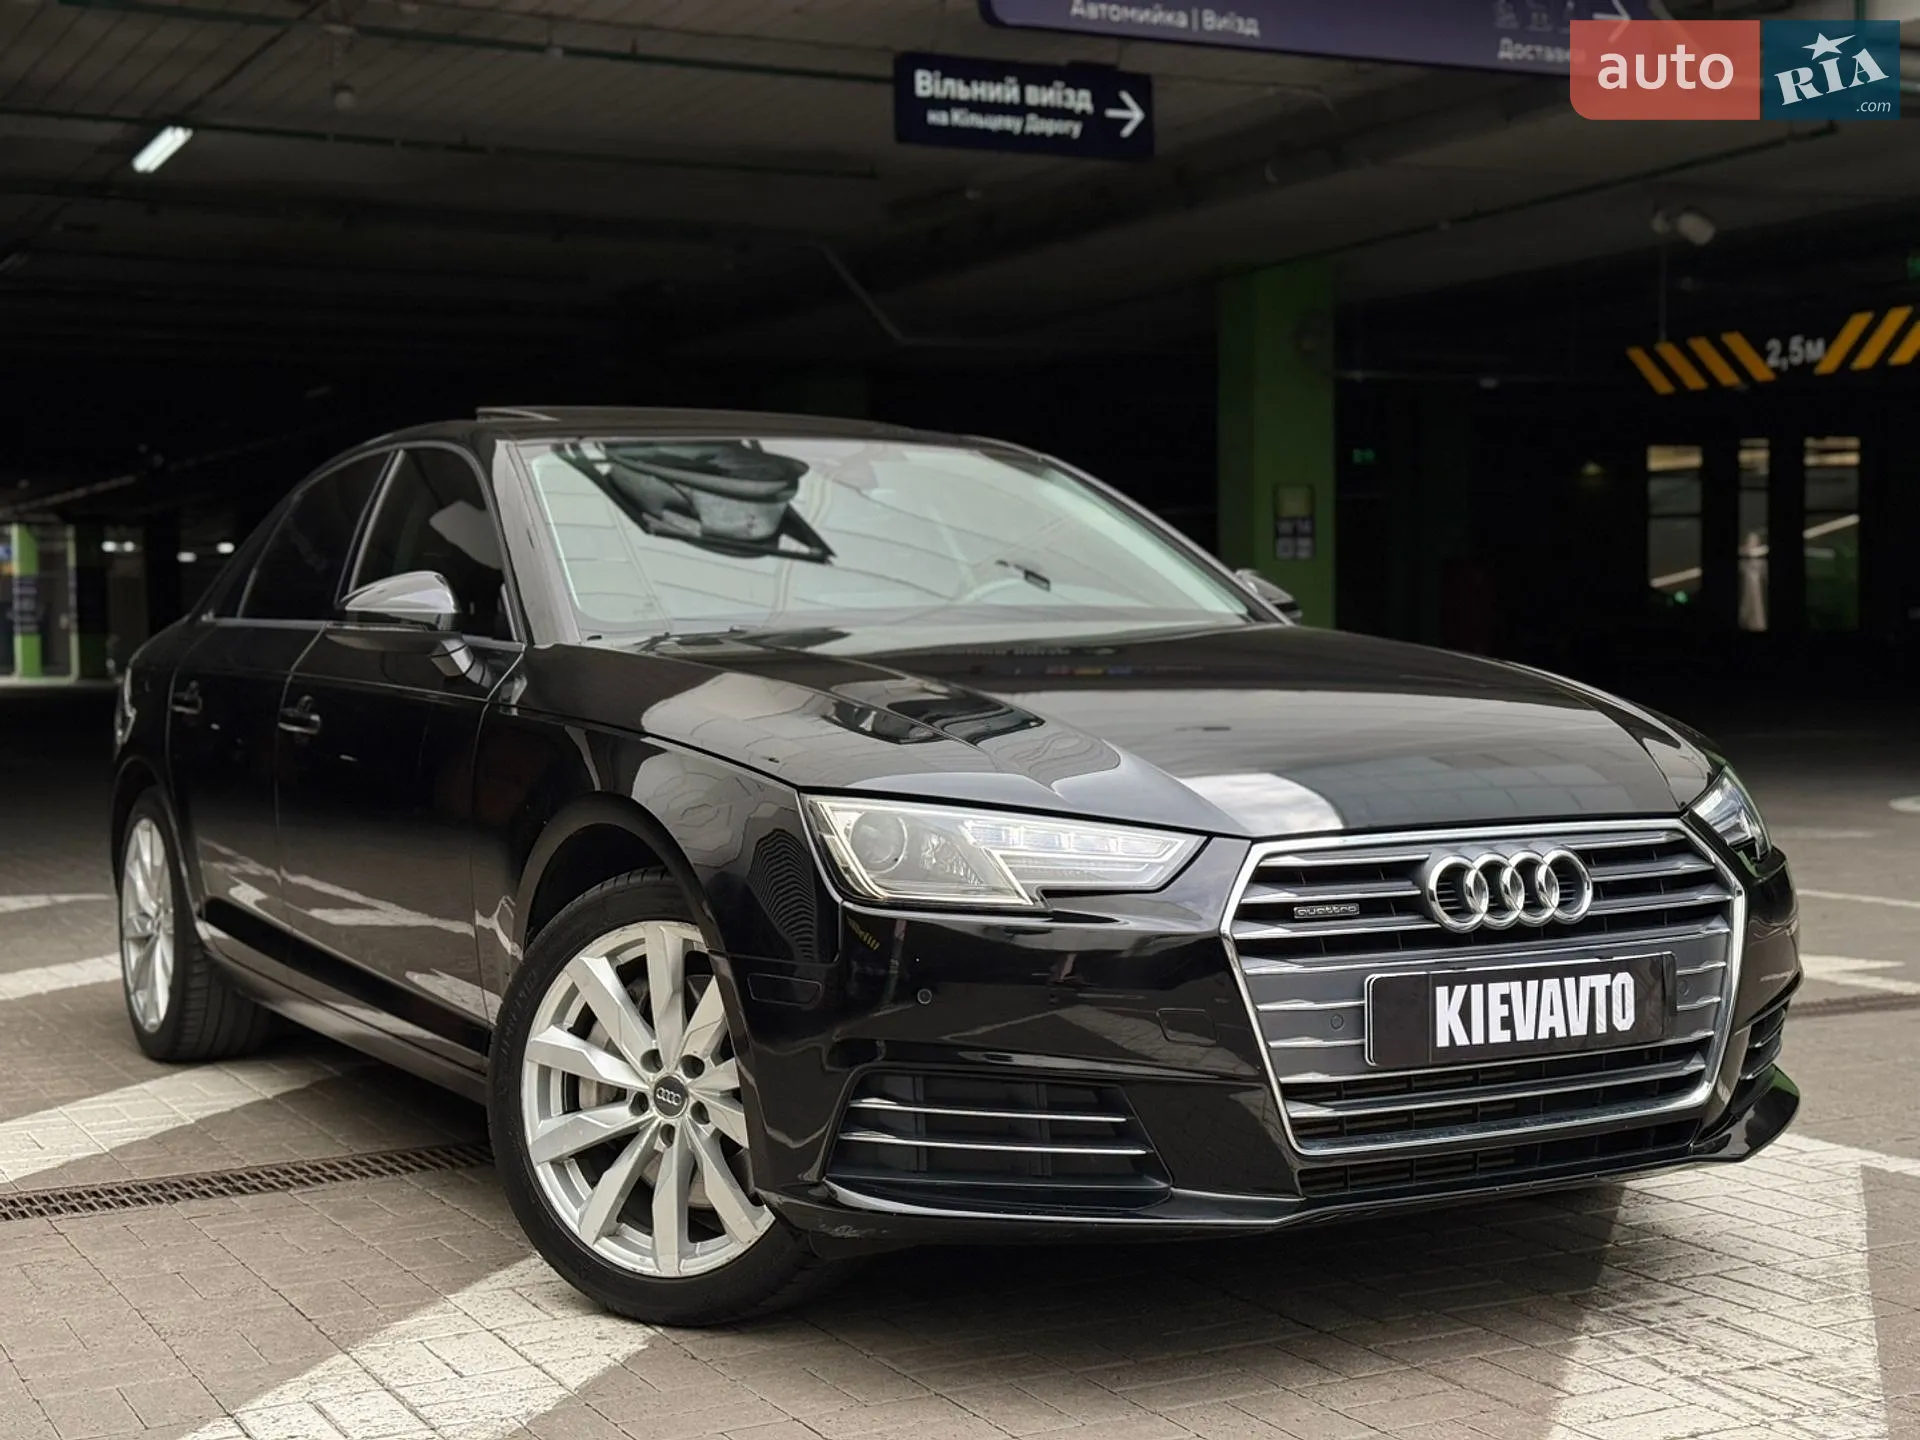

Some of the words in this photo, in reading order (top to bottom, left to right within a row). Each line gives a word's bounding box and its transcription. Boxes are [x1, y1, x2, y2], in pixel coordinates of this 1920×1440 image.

[1201, 8, 1260, 38] Виїзд
[913, 67, 1021, 106] Вільний
[1024, 79, 1095, 116] виїзд
[1296, 904, 1358, 918] quattro
[1434, 971, 1637, 1048] KIEVAVTO
